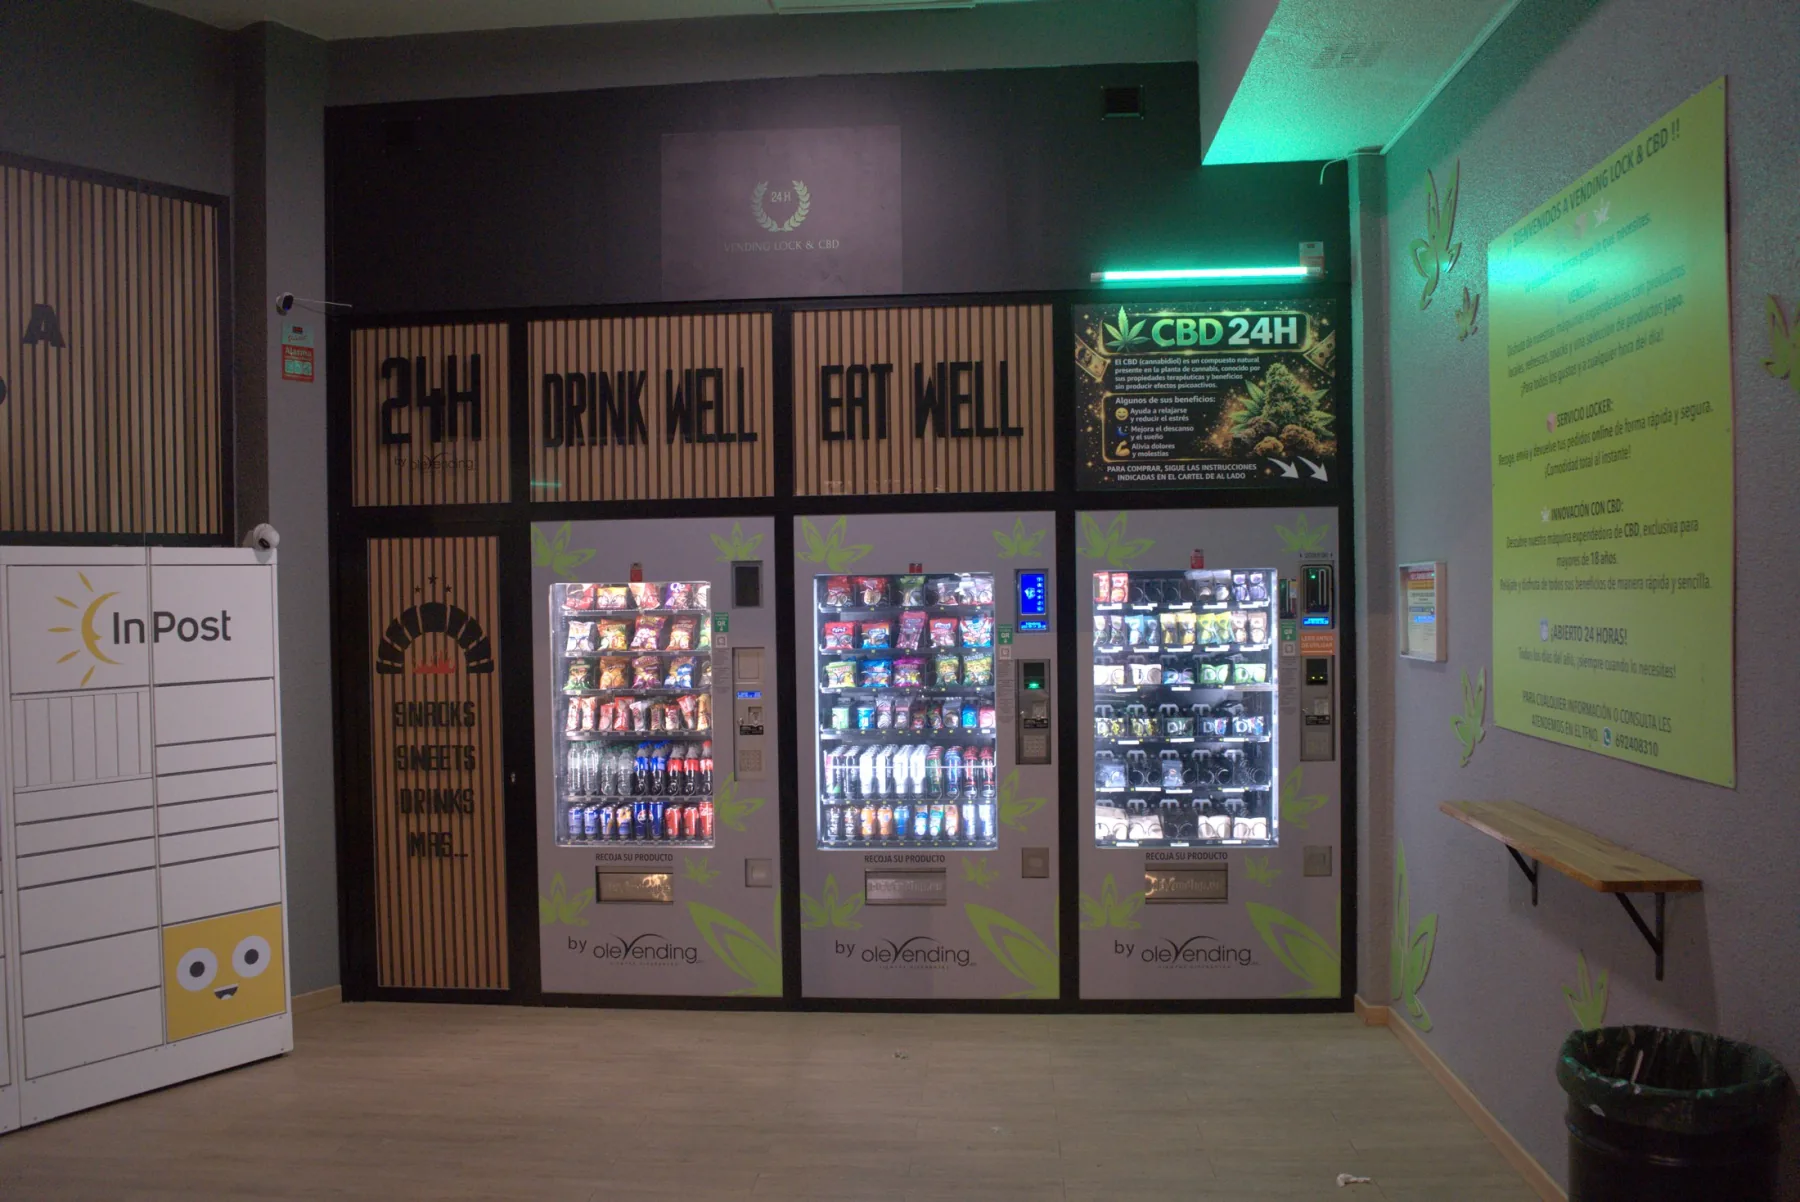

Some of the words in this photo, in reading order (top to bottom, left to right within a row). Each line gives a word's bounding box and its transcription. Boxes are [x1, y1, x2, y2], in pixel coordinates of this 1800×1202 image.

[1569, 169, 1608, 210] VENDING
[1610, 150, 1634, 183] LOCK
[1636, 144, 1644, 165] &
[1646, 128, 1668, 158] CBD
[725, 241, 771, 253] VENDING
[774, 239, 802, 252] LOCK
[805, 239, 815, 251] &
[818, 238, 840, 251] CBD
[1151, 317, 1224, 347] CBD
[1228, 316, 1297, 345] 24H
[1123, 358, 1138, 366] CBD
[1139, 358, 1182, 366] (cannabidiol)
[1161, 366, 1181, 374] planta
[1125, 383, 1153, 391] producir
[1177, 382, 1218, 390] psicoactivos.
[1166, 374, 1205, 382] terapéuticas
[382, 354, 481, 444] 24H
[542, 369, 649, 448] DRINK
[666, 366, 758, 445] WELL
[821, 363, 893, 441] EAT
[914, 360, 1024, 438] WELL
[1115, 397, 1147, 406] Algunos
[1130, 407, 1151, 415] Ayuda
[1158, 407, 1188, 415] relajarse
[1556, 406, 1584, 427] SERVICIO
[1592, 424, 1613, 442] online
[1615, 420, 1623, 436] de
[1624, 417, 1646, 432] forma
[1648, 406, 1672, 431] rápida
[1674, 409, 1679, 426] y
[1680, 400, 1714, 422] segura.
[1107, 465, 1126, 473] PARA
[1127, 465, 1163, 473] COMPRAR,
[1201, 463, 1257, 472] INSTRUCCIONES
[1168, 473, 1176, 481] EL
[1226, 472, 1246, 480] LADO
[1551, 500, 1589, 521] INNOVACIÓN
[1590, 500, 1605, 516] CON
[1607, 498, 1624, 514] CBD:
[1614, 524, 1623, 539] de
[1624, 521, 1642, 539] CBD,
[1643, 517, 1678, 536] exclusiva
[1680, 520, 1699, 538] para
[1581, 552, 1589, 566] de
[1590, 551, 1600, 565] 18
[1607, 576, 1616, 590] de
[1645, 573, 1670, 594] rápida
[1678, 572, 1712, 589] sencilla.
[113, 609, 231, 645] InPost
[1584, 627, 1594, 643] 24
[1596, 627, 1627, 646] HORAS!
[395, 701, 476, 728] SNACKS
[1620, 708, 1657, 732] CONSULTA
[1658, 717, 1672, 733] LES
[1615, 732, 1659, 757] 692408310
[397, 744, 476, 771] SWEETS
[400, 788, 475, 814] DRINKS
[595, 853, 622, 862] RECOJA
[623, 853, 633, 862] SU
[634, 852, 674, 862] PRODUCTO
[864, 854, 892, 863] RECOJA
[893, 854, 904, 863] SU
[905, 854, 946, 863] PRODUCTO
[1145, 851, 1174, 860] RECOJA
[1175, 851, 1185, 860] SU
[1187, 851, 1228, 860] PRODUCTO
[568, 935, 587, 954] by
[835, 939, 856, 957] by
[1114, 939, 1135, 958] by
